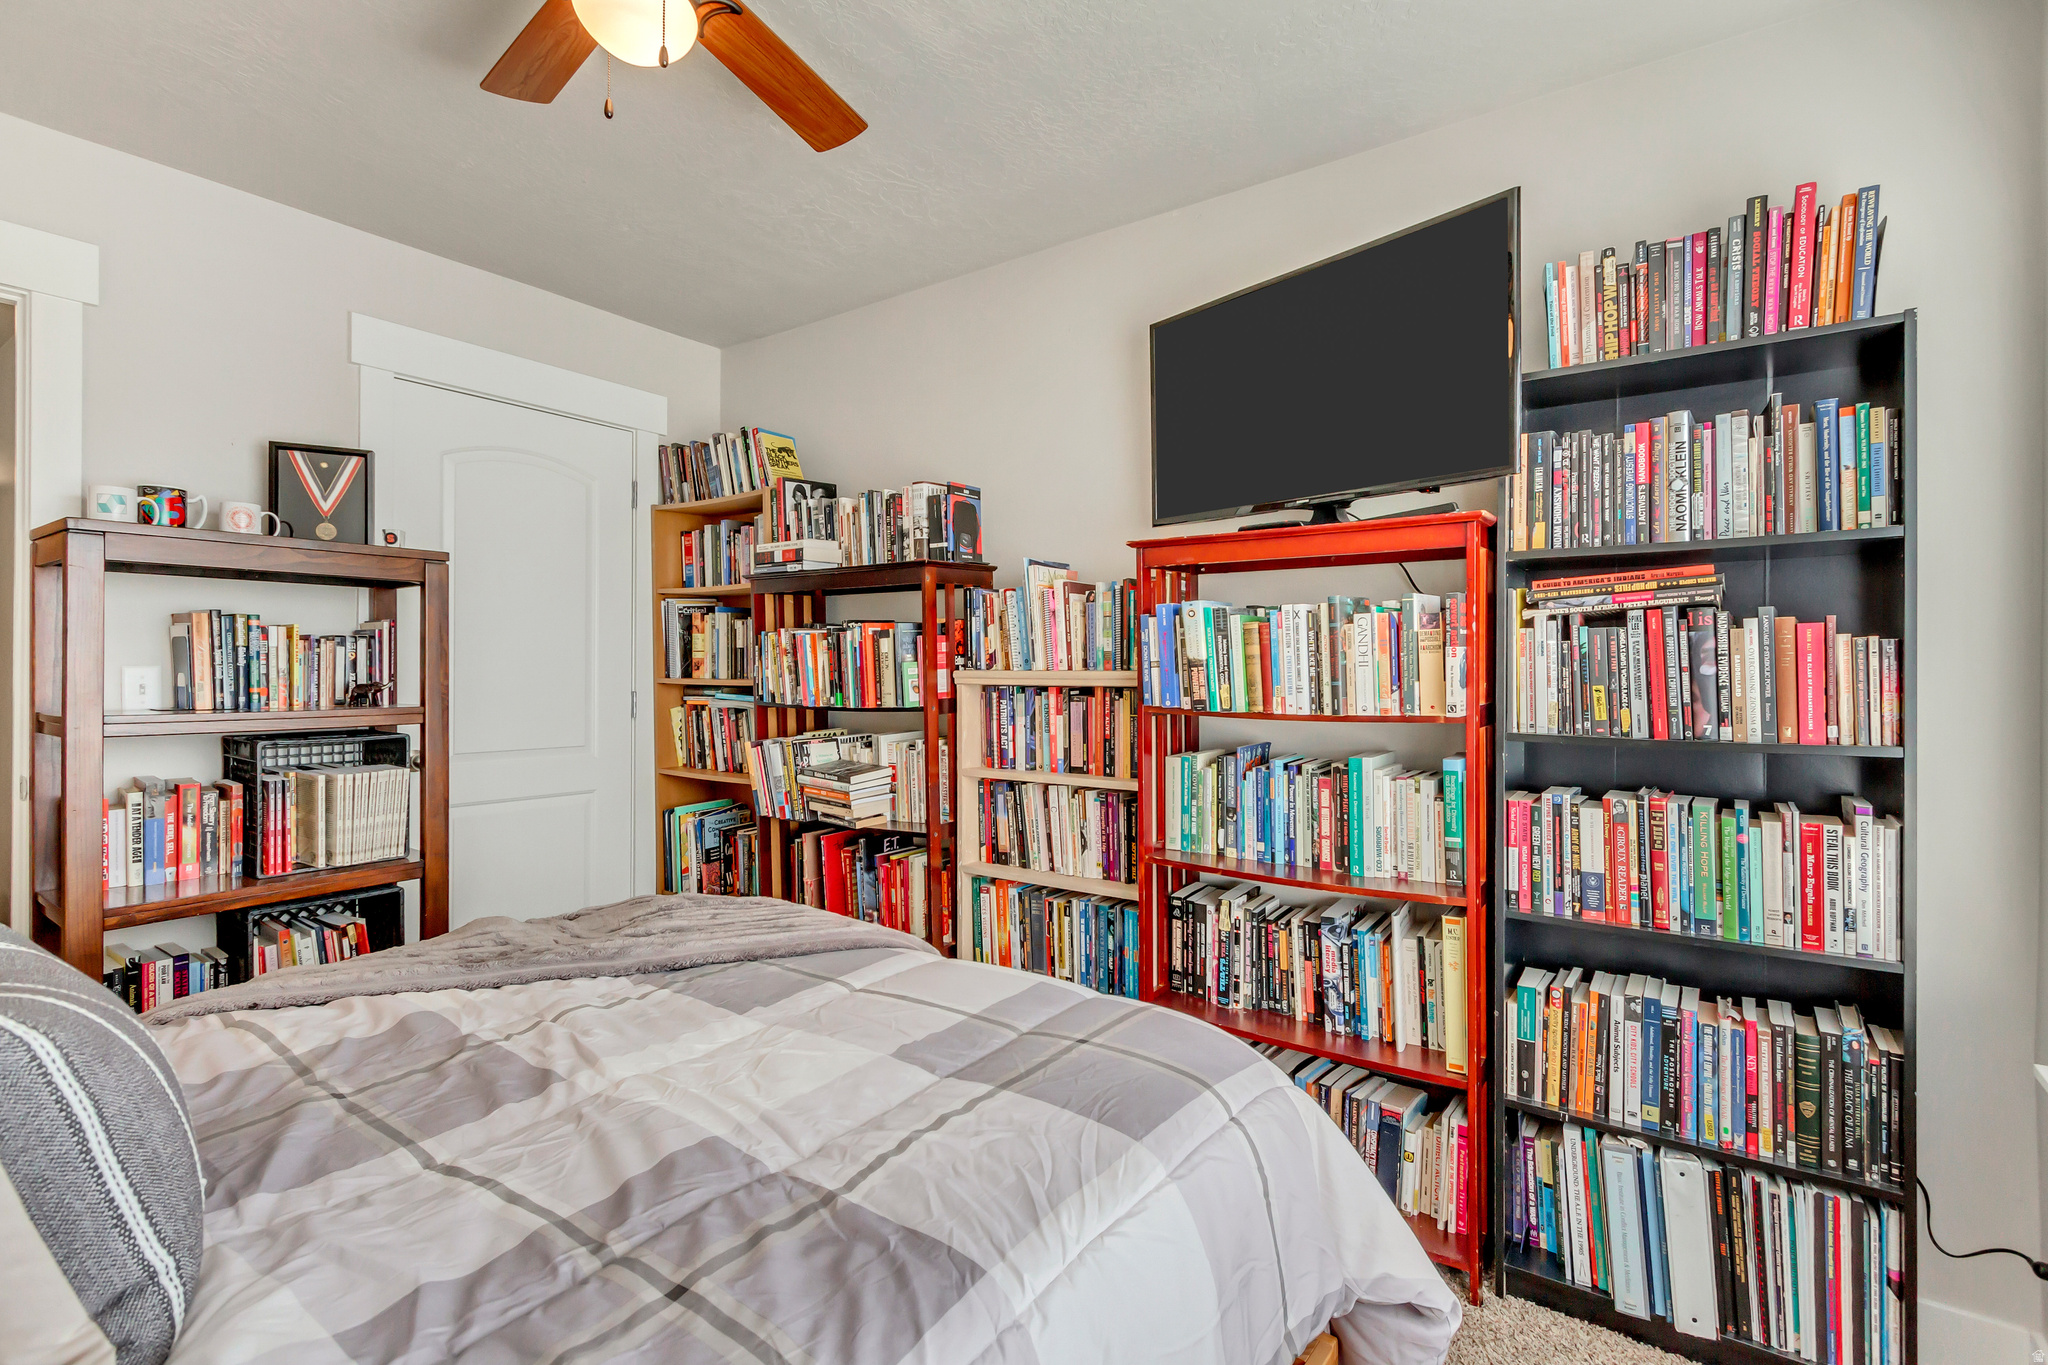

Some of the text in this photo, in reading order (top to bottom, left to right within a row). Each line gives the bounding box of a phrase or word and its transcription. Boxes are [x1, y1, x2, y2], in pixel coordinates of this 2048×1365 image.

[1866, 190, 1875, 227] REWEAVING
[1864, 243, 1872, 265] WORLD
[1695, 267, 1703, 330] HOW ANIMALS TALK
[1604, 301, 1617, 332] HOP
[1584, 320, 1592, 353] Dynamics
[1604, 335, 1618, 354] HIP
[1593, 438, 1599, 447] WE
[1535, 467, 1543, 492] FEMINISMS
[1626, 455, 1634, 519] STRUCTURING DIVERSITY
[1676, 441, 1687, 532] NAOMI KLEIN
[1554, 487, 1562, 548] NOAM CHOMSKY
[1615, 581, 1658, 593] HIP HOP FILES
[1570, 603, 1618, 613] SOUTH AFRICA
[1624, 597, 1689, 609] PETER MAGUBANE
[1450, 598, 1459, 658] covert action
[1629, 615, 1642, 623] SPIKE
[1665, 618, 1673, 636] ANIMAL
[1698, 612, 1713, 626] is
[1356, 617, 1369, 667] GANDHI
[1717, 613, 1728, 654] INADMISSIBLE
[1666, 637, 1674, 666] OPPRESSION
[1680, 631, 1690, 703] INTENSIFICATION SURVEILLANCE
[1719, 656, 1728, 686] EVIDENCE
[1191, 667, 1199, 700] POWERFUL
[1668, 678, 1678, 707] CAPITALISM
[132, 822, 141, 845] TENDER
[1699, 812, 1708, 848] KILLING
[132, 847, 141, 859] AGE
[166, 842, 174, 855] SELL
[1532, 826, 1541, 882] GREEN NEW RED
[1571, 828, 1580, 870] ARMY OF NONE
[1826, 829, 1839, 891] STEAL THIS BOOK
[1859, 821, 1869, 892] Cultural Geography
[1617, 830, 1626, 901] GIROUX READER
[1639, 874, 1649, 900] planet
[1428, 978, 1434, 987] be
[1613, 1020, 1621, 1043] Animal
[1747, 1055, 1756, 1073] KEY
[1720, 1066, 1728, 1094] Psychology
[1844, 1085, 1853, 1113] LEGACY
[1845, 1127, 1853, 1148] LUNA
[1526, 1149, 1534, 1159] The
[1526, 1161, 1534, 1192] Education
[1528, 1192, 1535, 1201] of
